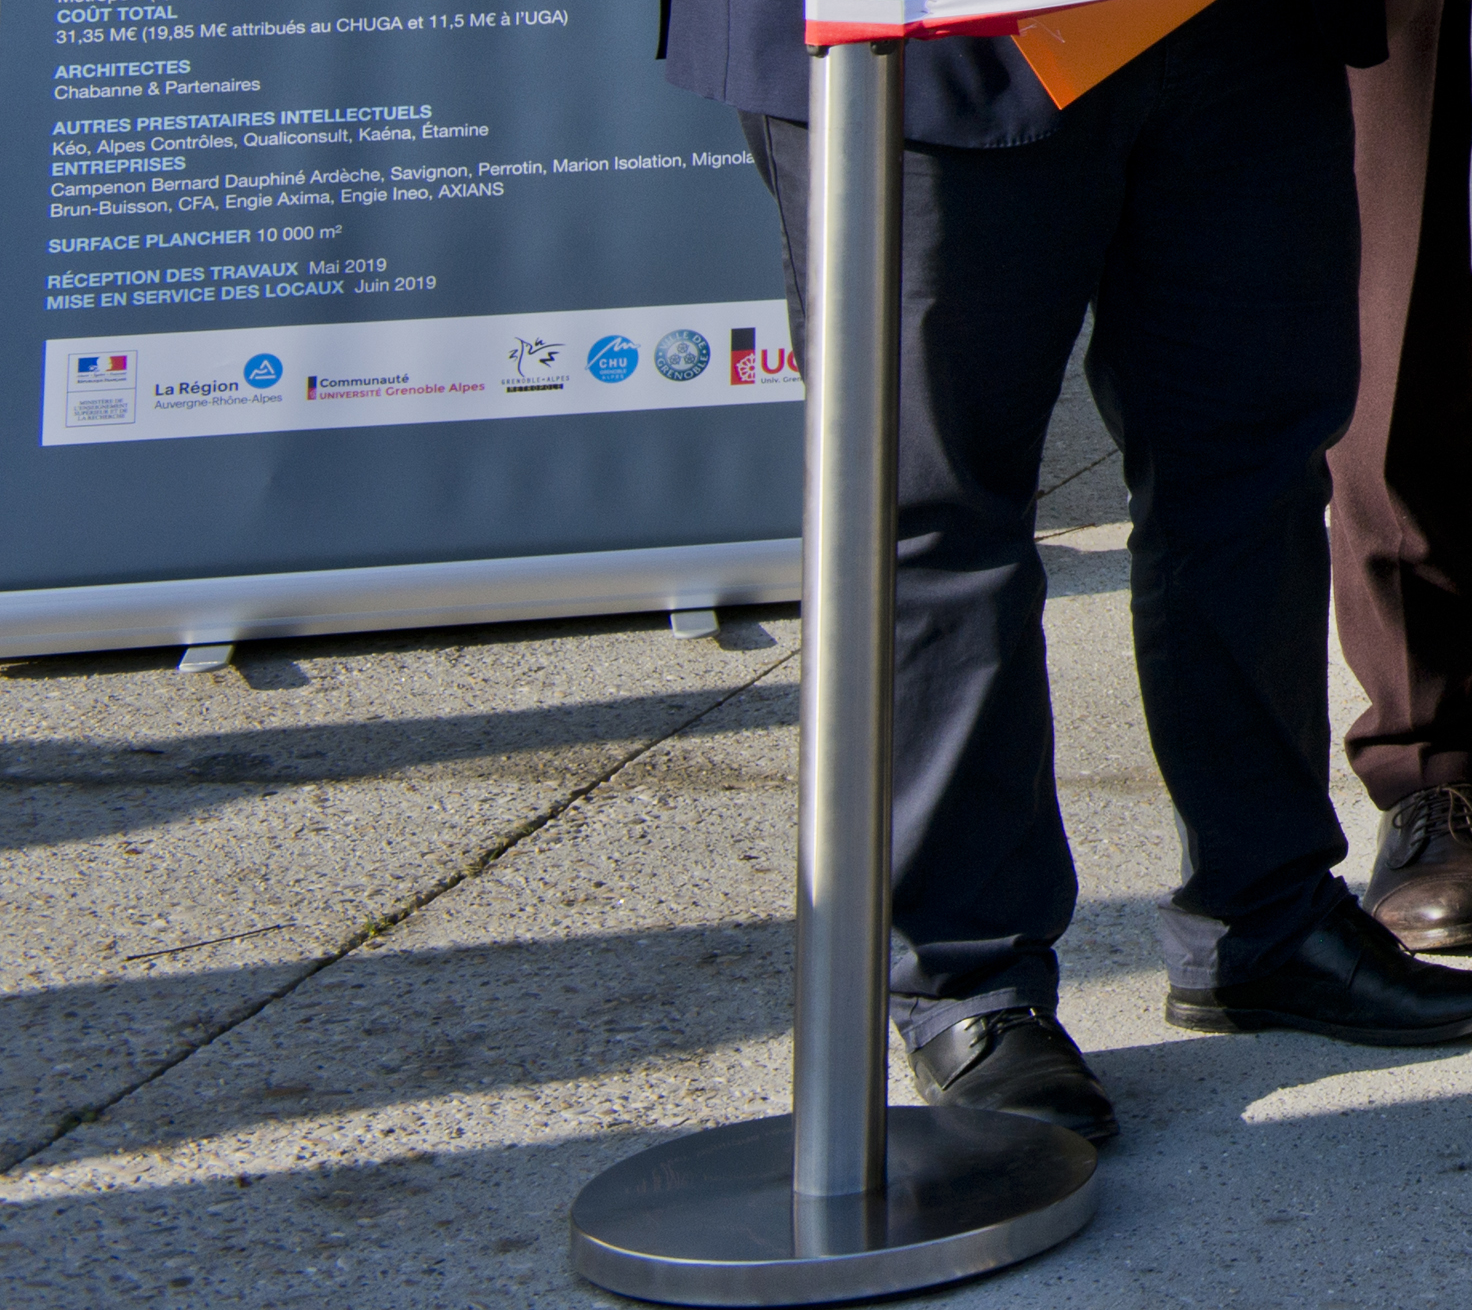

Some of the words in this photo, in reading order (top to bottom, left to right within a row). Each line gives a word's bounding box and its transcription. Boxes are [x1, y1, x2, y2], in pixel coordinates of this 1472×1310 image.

[118, 5, 178, 21] TOTAL
[55, 59, 191, 79] ARCHITECTES
[54, 85, 143, 100] Chabanne
[148, 81, 160, 96] &
[166, 78, 261, 95] Partenaires
[53, 118, 131, 135] AUTRES
[137, 111, 275, 131] PRESTATAIRES
[281, 104, 432, 124] INTELLECTUELS
[53, 140, 91, 156] Kéo,
[97, 139, 145, 155] Alpes
[151, 134, 237, 151] Contrôles,
[244, 128, 352, 147] Qualiconsult,
[359, 126, 416, 142] Kaéna,
[422, 122, 489, 139] Étamine
[52, 156, 186, 176] ENTREPRISES
[51, 200, 172, 218] Brun-Buisson,
[179, 195, 219, 211] CFA,
[226, 193, 273, 211] Engie
[277, 191, 334, 206] Axima,
[341, 187, 387, 206] Engie
[393, 187, 432, 201] Ineo,
[438, 181, 504, 199] AXIANS
[49, 235, 140, 254] SURFACE
[146, 229, 251, 248] PLANCHER
[258, 228, 278, 242] 10
[283, 225, 314, 241] 000
[48, 269, 160, 289] RÉCEPTION
[167, 266, 205, 283] DES
[211, 262, 298, 280] TRAVAUX
[310, 260, 339, 275] Mai
[345, 258, 387, 273] 2019
[47, 293, 94, 309] MISE
[101, 292, 127, 307] EN
[133, 287, 215, 305] SERVICE
[222, 284, 260, 300] DES
[266, 280, 344, 298] LOCAUX
[355, 278, 389, 293] Juin
[395, 275, 436, 291] 2019
[599, 357, 628, 369] CHU
[656, 354, 709, 380] GRENOBLE
[154, 383, 175, 396] La
[179, 380, 240, 397] Région
[319, 373, 410, 388] Communauté
[319, 387, 382, 400] UNIVERSITÉ
[385, 383, 446, 397] Grenoble
[448, 382, 486, 396] Alpes
[154, 393, 283, 410] Auvergne-Rhône-Alpes
